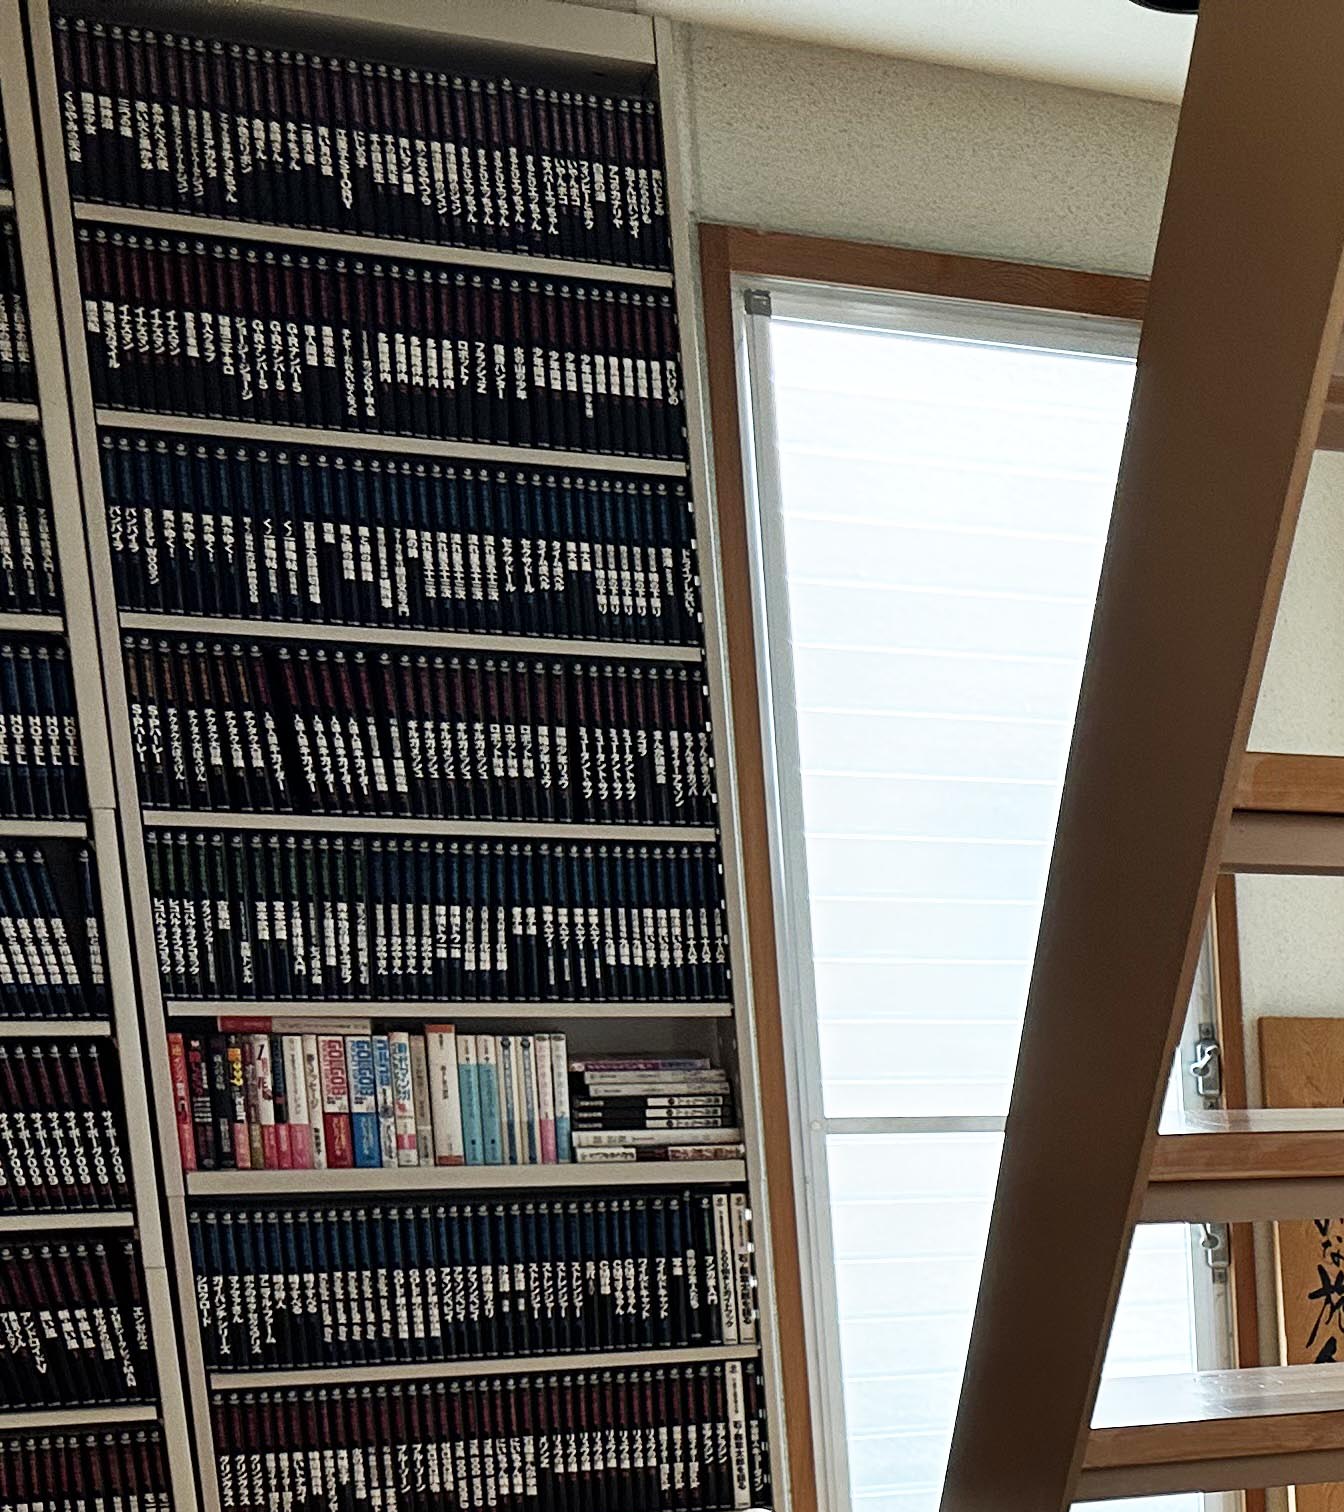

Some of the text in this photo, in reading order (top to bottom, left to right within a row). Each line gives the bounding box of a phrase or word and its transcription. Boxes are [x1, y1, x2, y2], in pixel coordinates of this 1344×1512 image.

[10, 715, 27, 764] HOTEL
[29, 716, 45, 765] HOTEL
[46, 716, 62, 765] HOTEL
[64, 717, 78, 765] HOTEL
[0, 1113, 25, 1185] サイボーグ009
[14, 1113, 42, 1185] サイボーグ009
[31, 1113, 58, 1185] サイボーグ009
[48, 1112, 74, 1184] サイボーグ009
[64, 1112, 90, 1184] サイボーグ009
[84, 1112, 108, 1184] サイボーグ009
[102, 1111, 125, 1183] サイボーグ009
